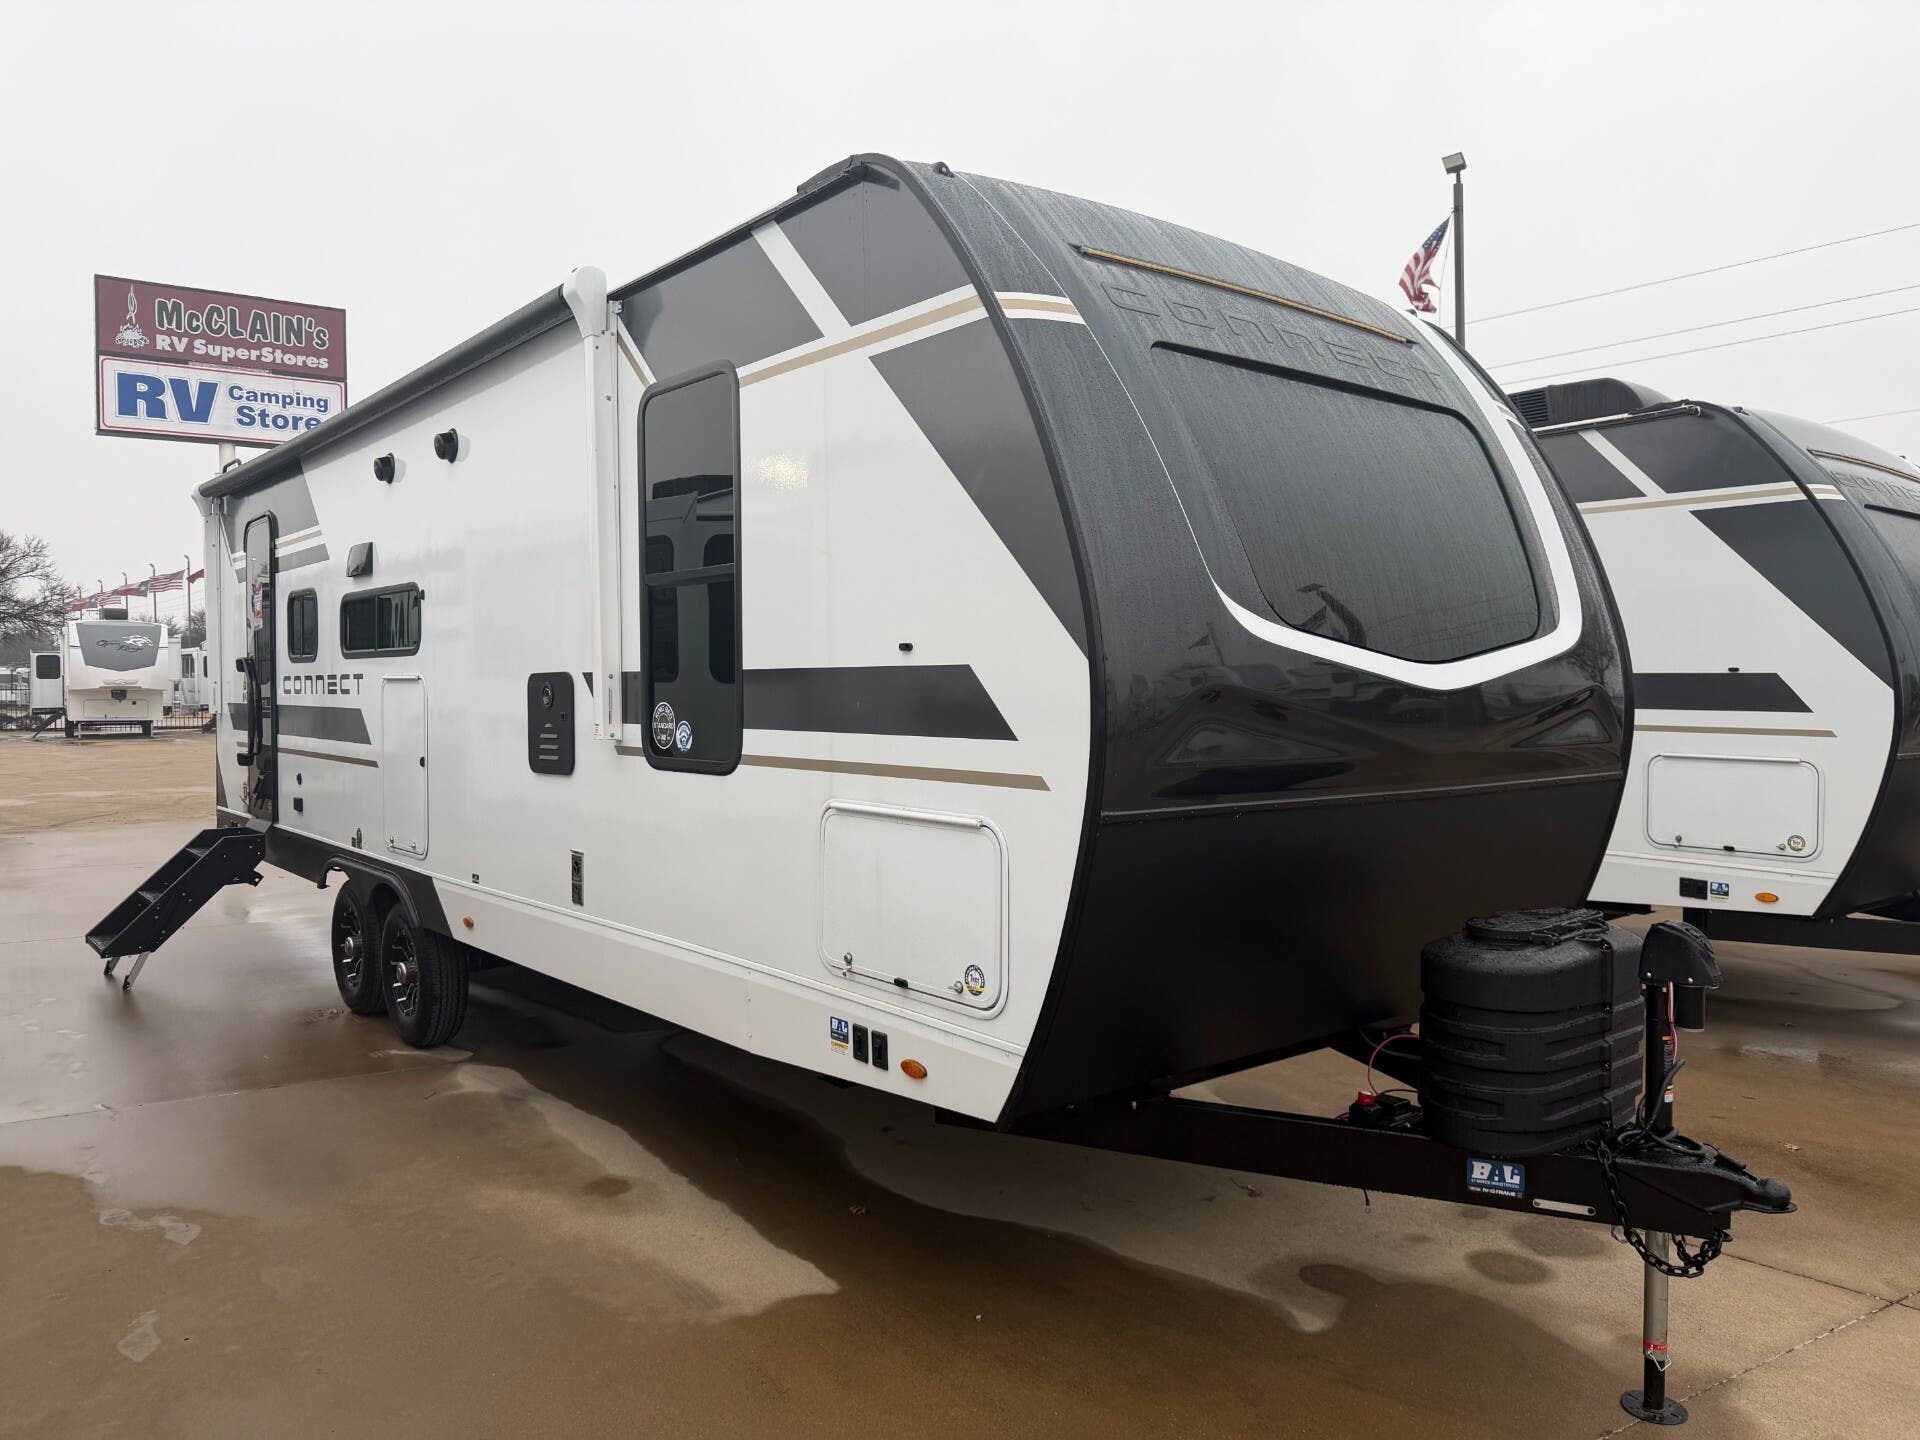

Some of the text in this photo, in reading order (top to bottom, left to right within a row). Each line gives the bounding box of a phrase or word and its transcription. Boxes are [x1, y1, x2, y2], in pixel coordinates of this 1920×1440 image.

[155, 334, 329, 369] RV SuperStores
[116, 371, 219, 423] RV
[228, 385, 329, 413] Camping
[236, 405, 322, 431] Store
[283, 673, 363, 695] CONNECT
